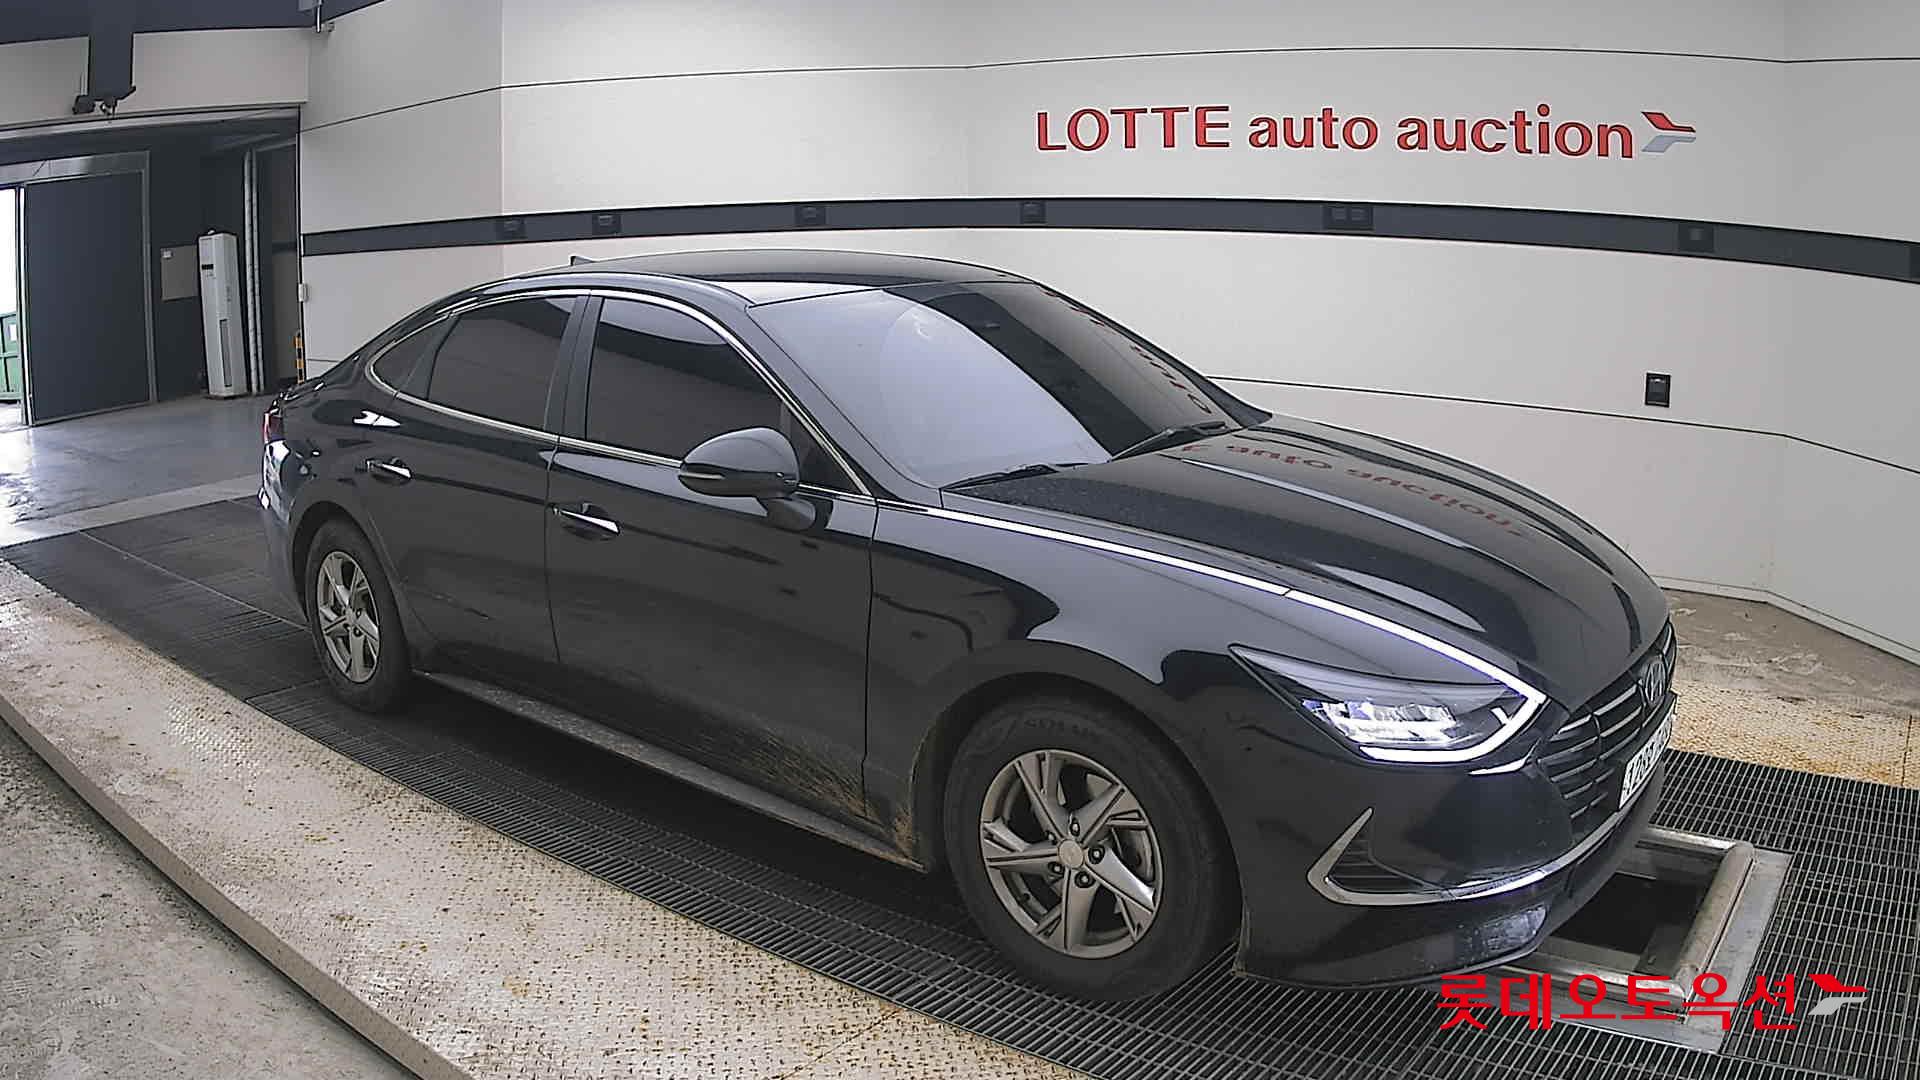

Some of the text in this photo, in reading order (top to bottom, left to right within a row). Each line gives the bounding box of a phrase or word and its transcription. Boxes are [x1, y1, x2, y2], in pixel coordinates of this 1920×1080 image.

[1037, 104, 1634, 158] LOTTE auto auction
